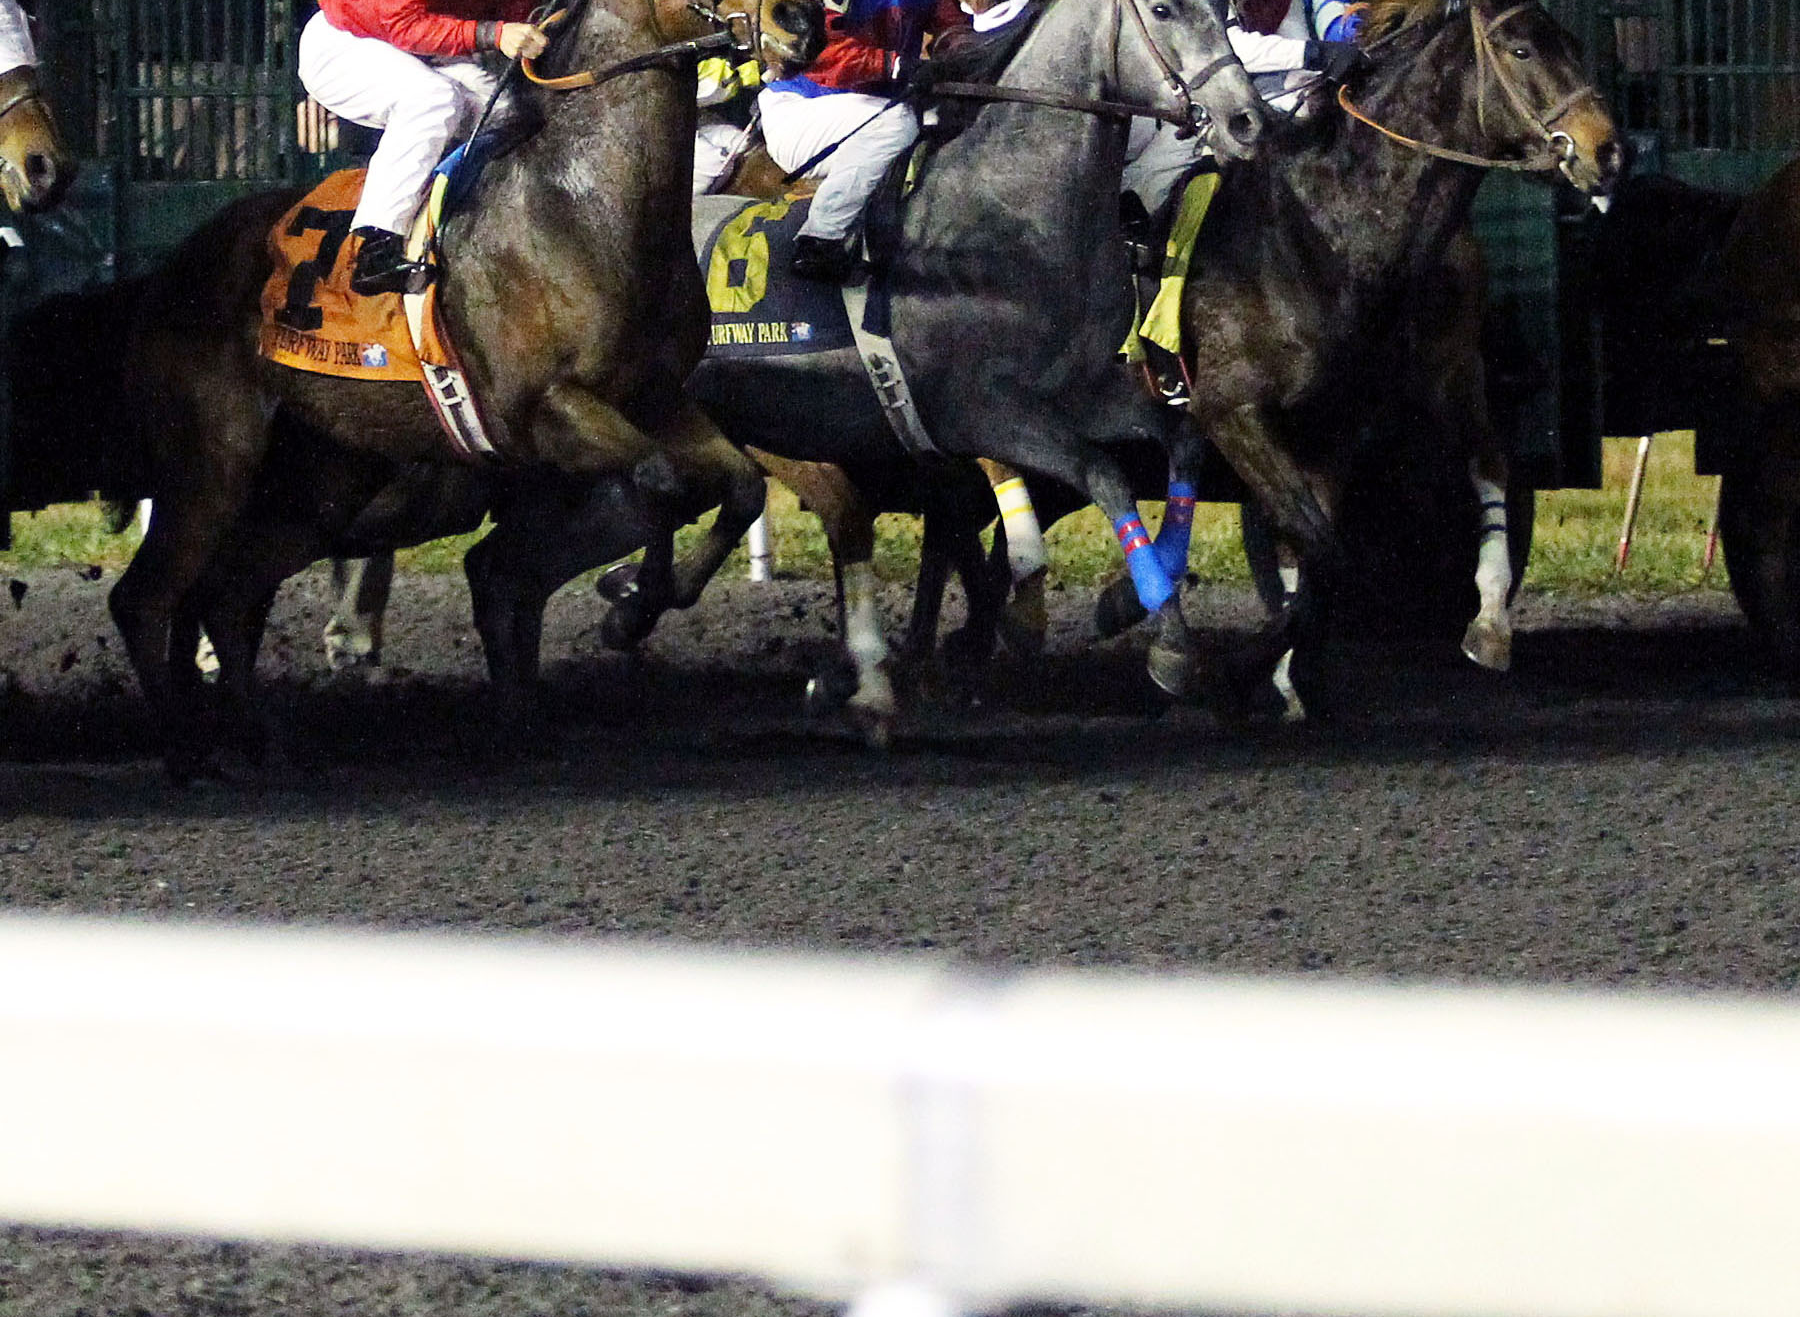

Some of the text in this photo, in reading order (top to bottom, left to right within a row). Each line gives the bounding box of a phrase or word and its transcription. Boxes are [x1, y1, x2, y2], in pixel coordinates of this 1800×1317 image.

[275, 205, 357, 331] 7
[706, 201, 791, 313] 6
[707, 321, 789, 346] URFWAY PARK
